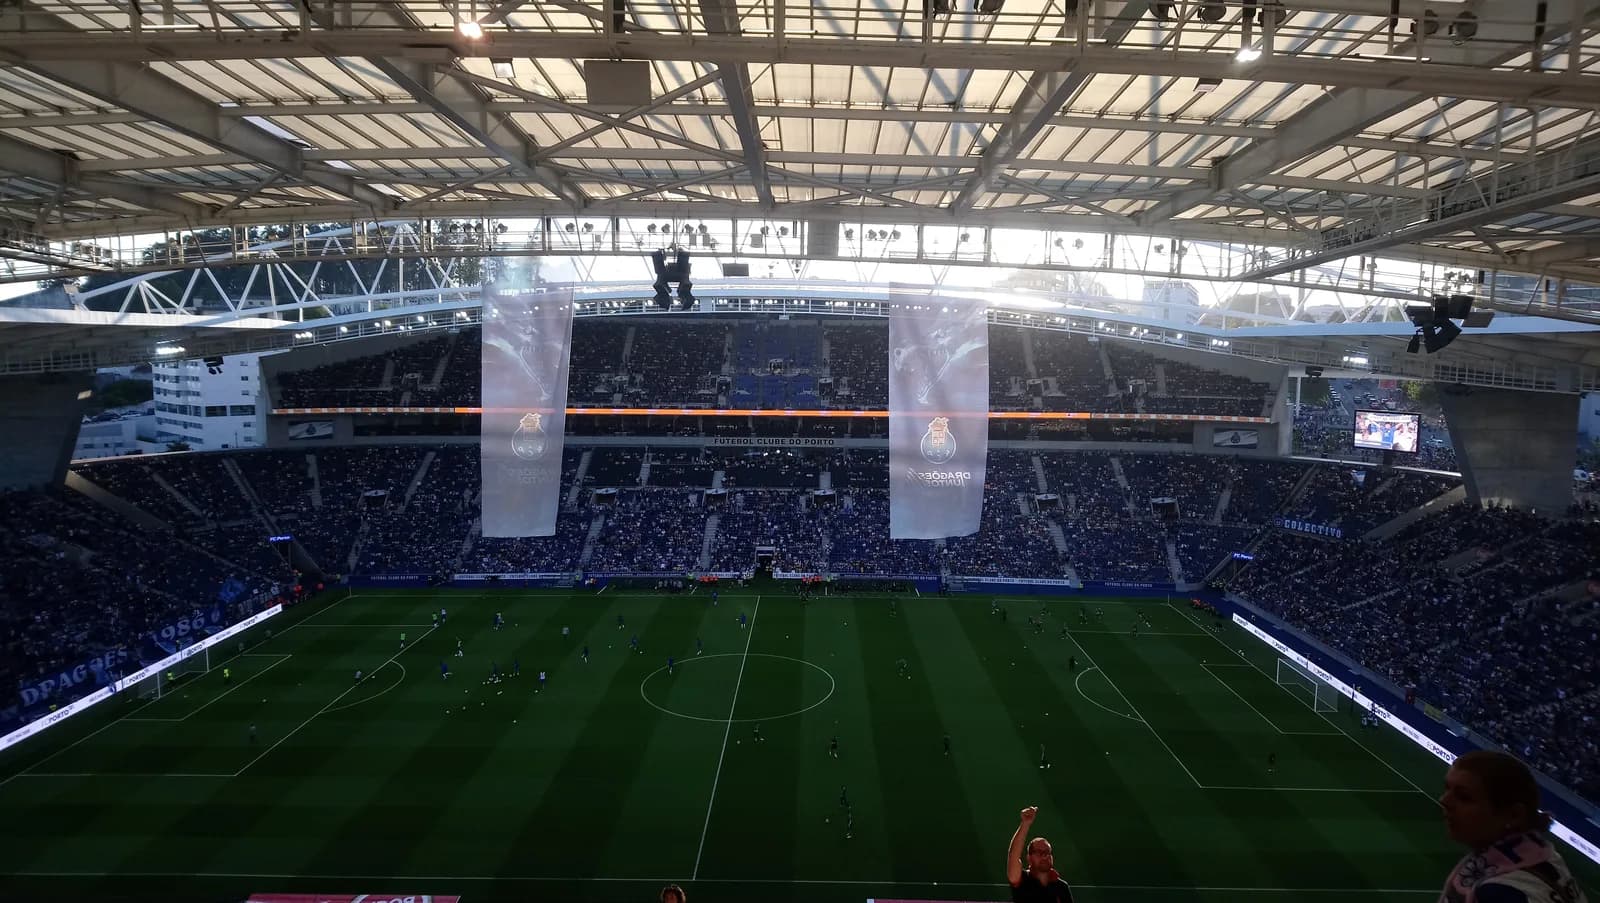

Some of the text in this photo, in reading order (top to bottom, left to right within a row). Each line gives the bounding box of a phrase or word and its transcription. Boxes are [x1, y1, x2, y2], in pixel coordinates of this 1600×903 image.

[714, 438, 834, 446] FUTEBOL CLUBE DO PORTO
